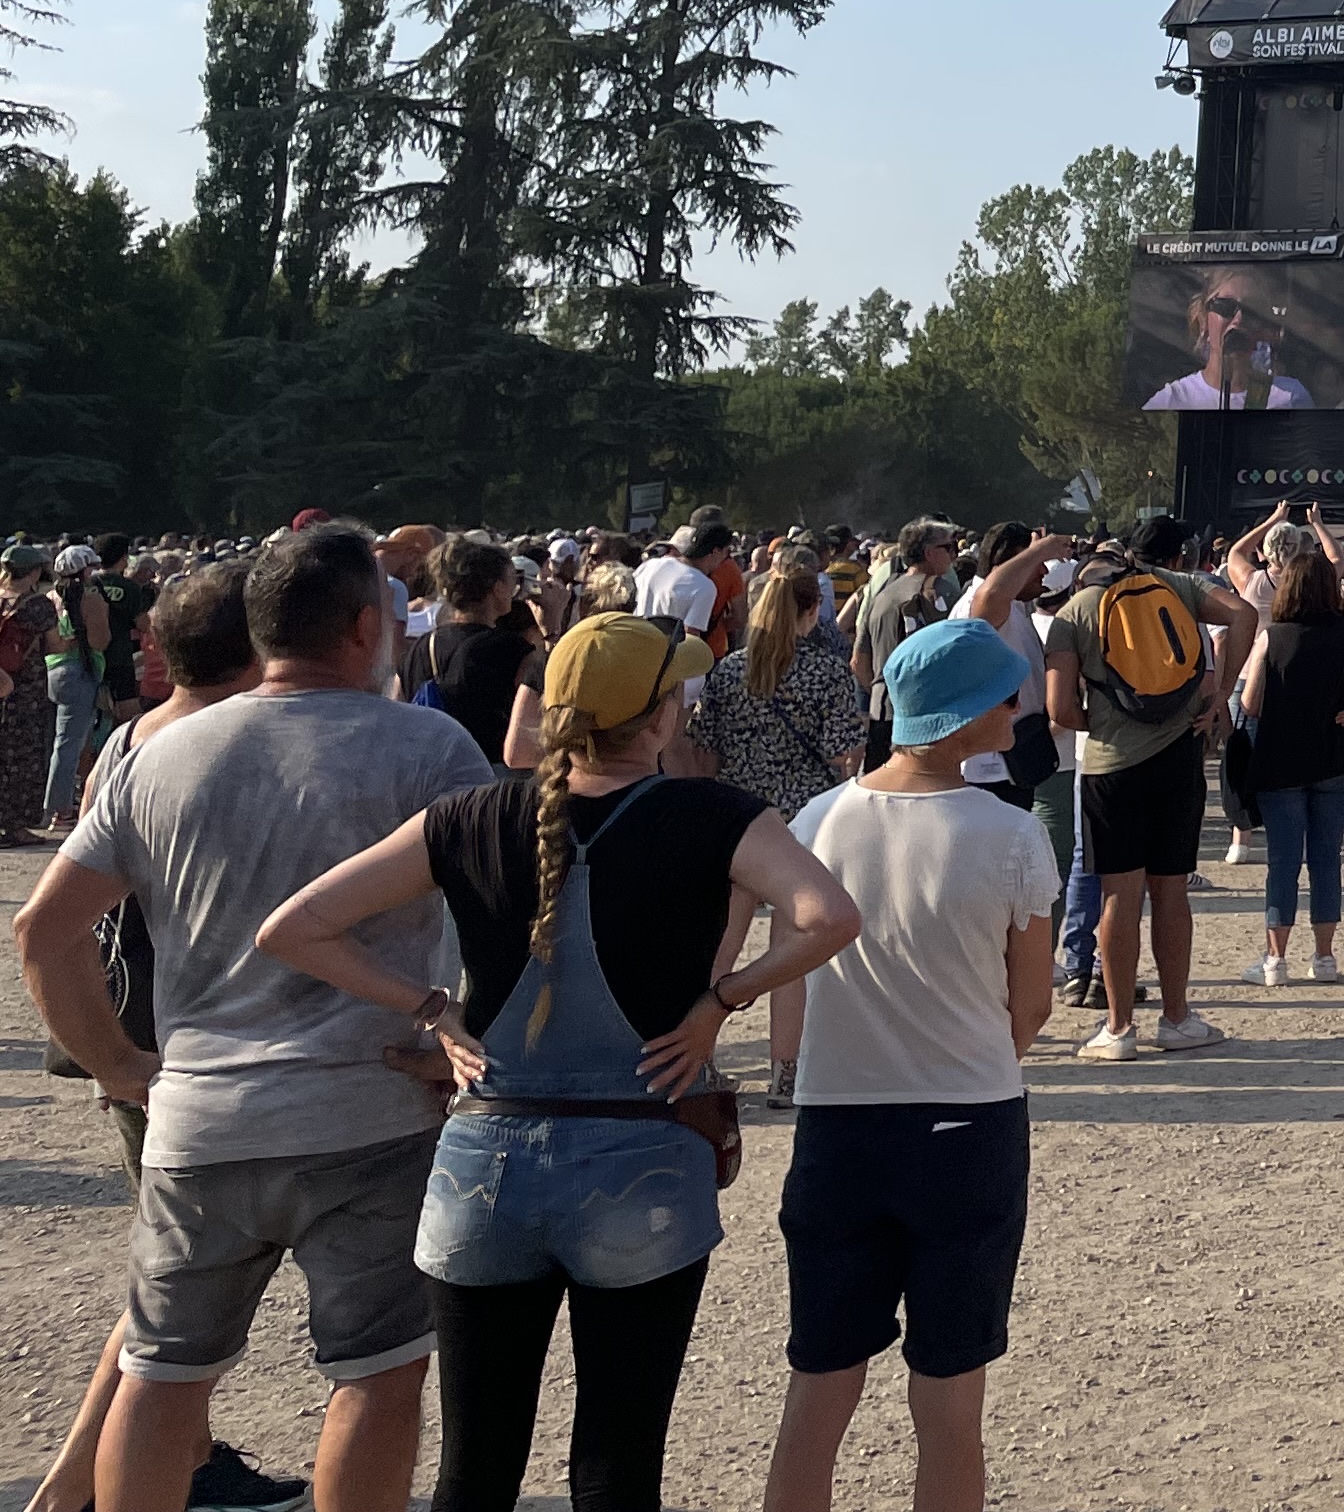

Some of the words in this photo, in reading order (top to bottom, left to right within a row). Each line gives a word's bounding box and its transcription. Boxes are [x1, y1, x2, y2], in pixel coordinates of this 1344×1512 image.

[1252, 28, 1295, 44] ALBI
[1252, 43, 1284, 58] SON
[1285, 41, 1344, 58] FESTIVAL
[1147, 244, 1160, 254] LE
[1162, 241, 1202, 253] CRÉDIT
[1204, 241, 1249, 253] MUTUEL
[1251, 241, 1292, 252] DONNE
[1294, 241, 1309, 251] LE
